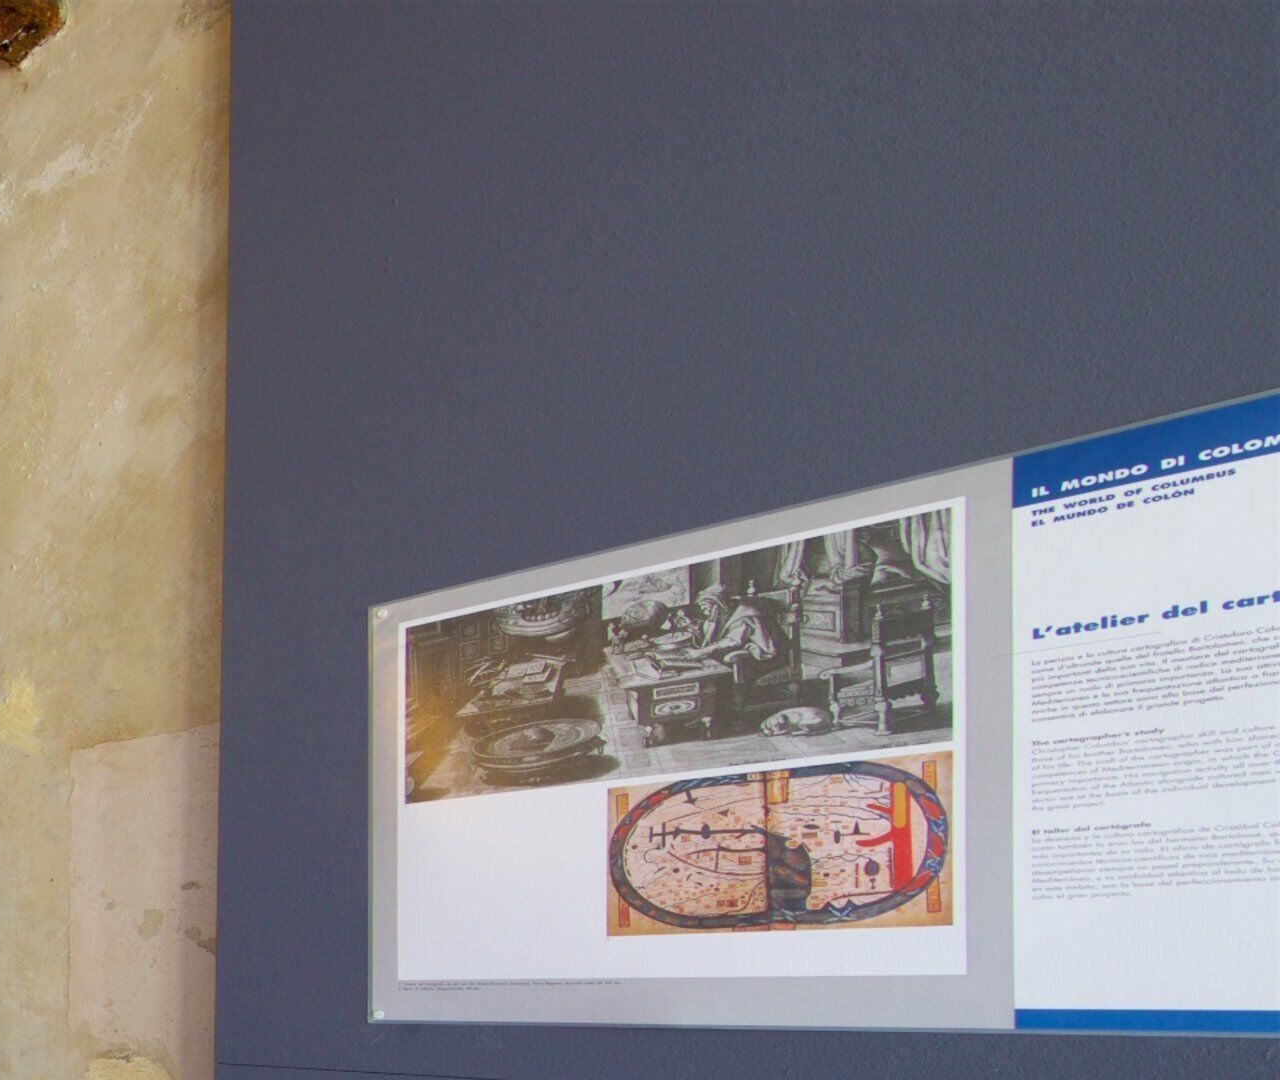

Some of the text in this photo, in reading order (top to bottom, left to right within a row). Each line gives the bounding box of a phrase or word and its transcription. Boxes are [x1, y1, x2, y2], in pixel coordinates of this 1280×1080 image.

[1031, 434, 1280, 498] IL MONDO DI COLOM
[1031, 468, 1237, 517] THE WORLD OF COLUMBUS
[1031, 519, 1045, 528] EL
[1053, 506, 1108, 523] MUNDO
[1116, 500, 1135, 511] DE
[1162, 600, 1208, 620] del
